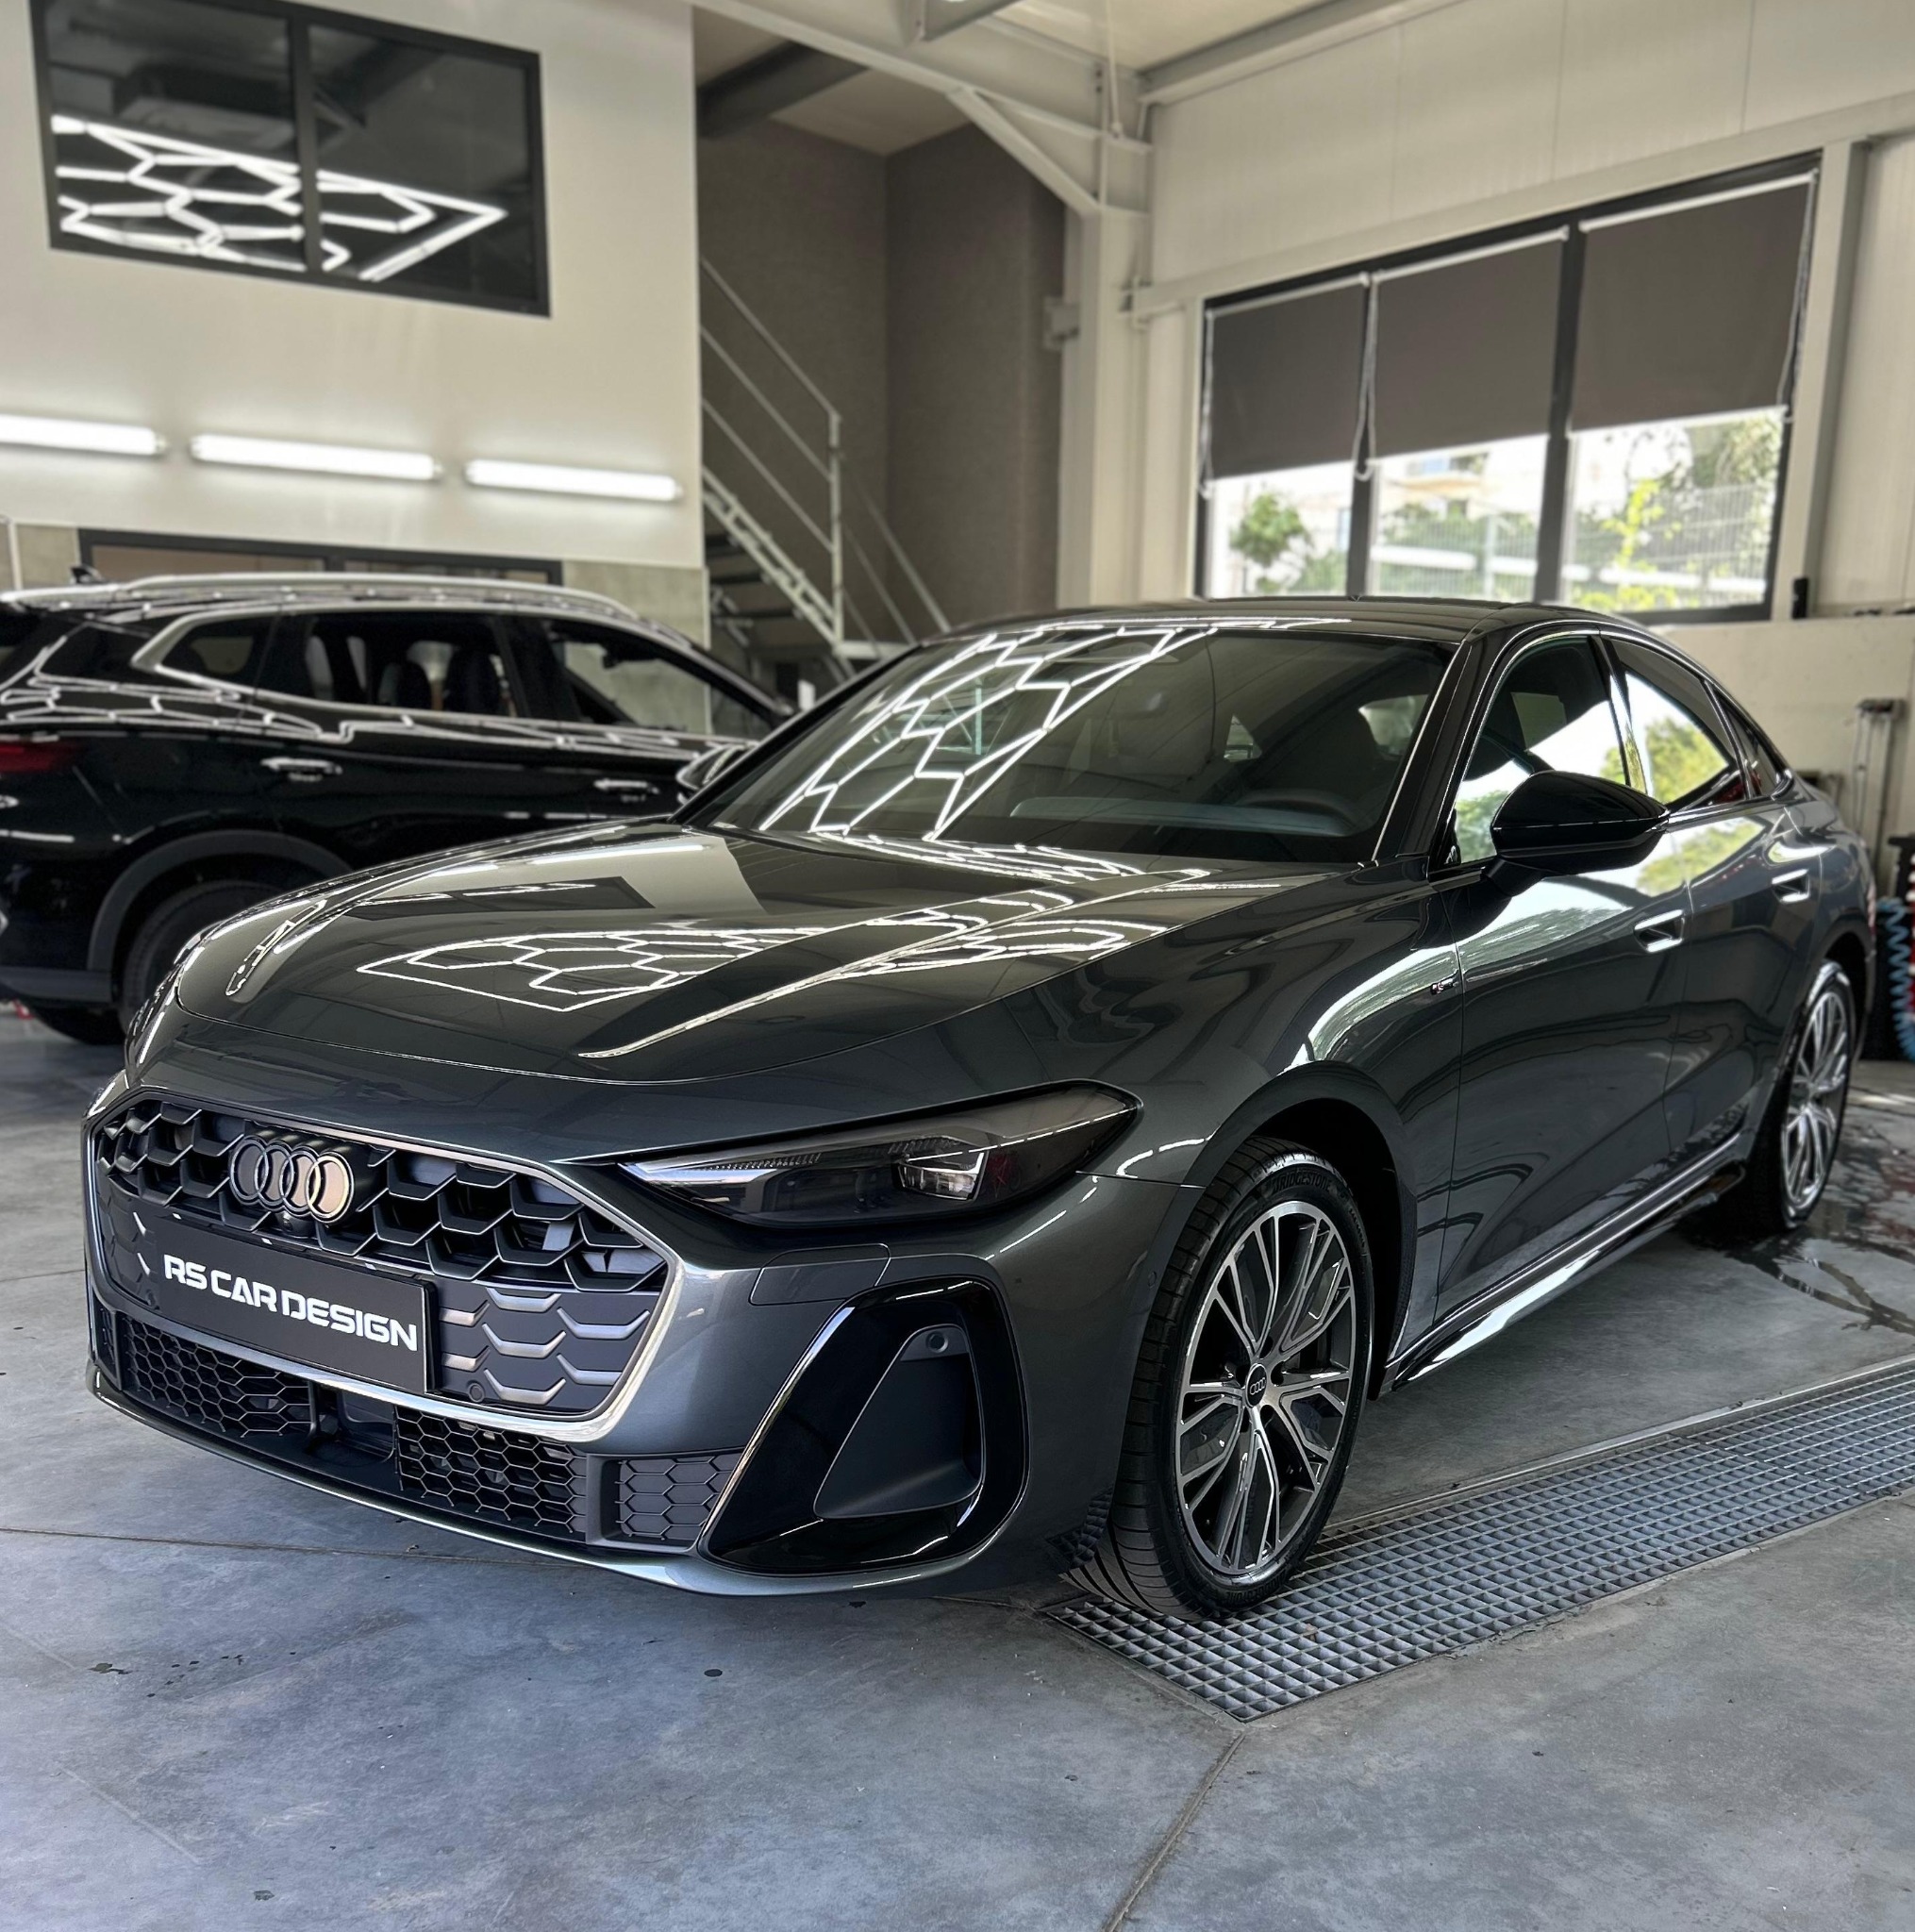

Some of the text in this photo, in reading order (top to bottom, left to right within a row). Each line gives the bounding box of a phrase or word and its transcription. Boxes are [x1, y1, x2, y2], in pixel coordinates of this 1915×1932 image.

[163, 1254, 418, 1352] RS CAR DESIGN
